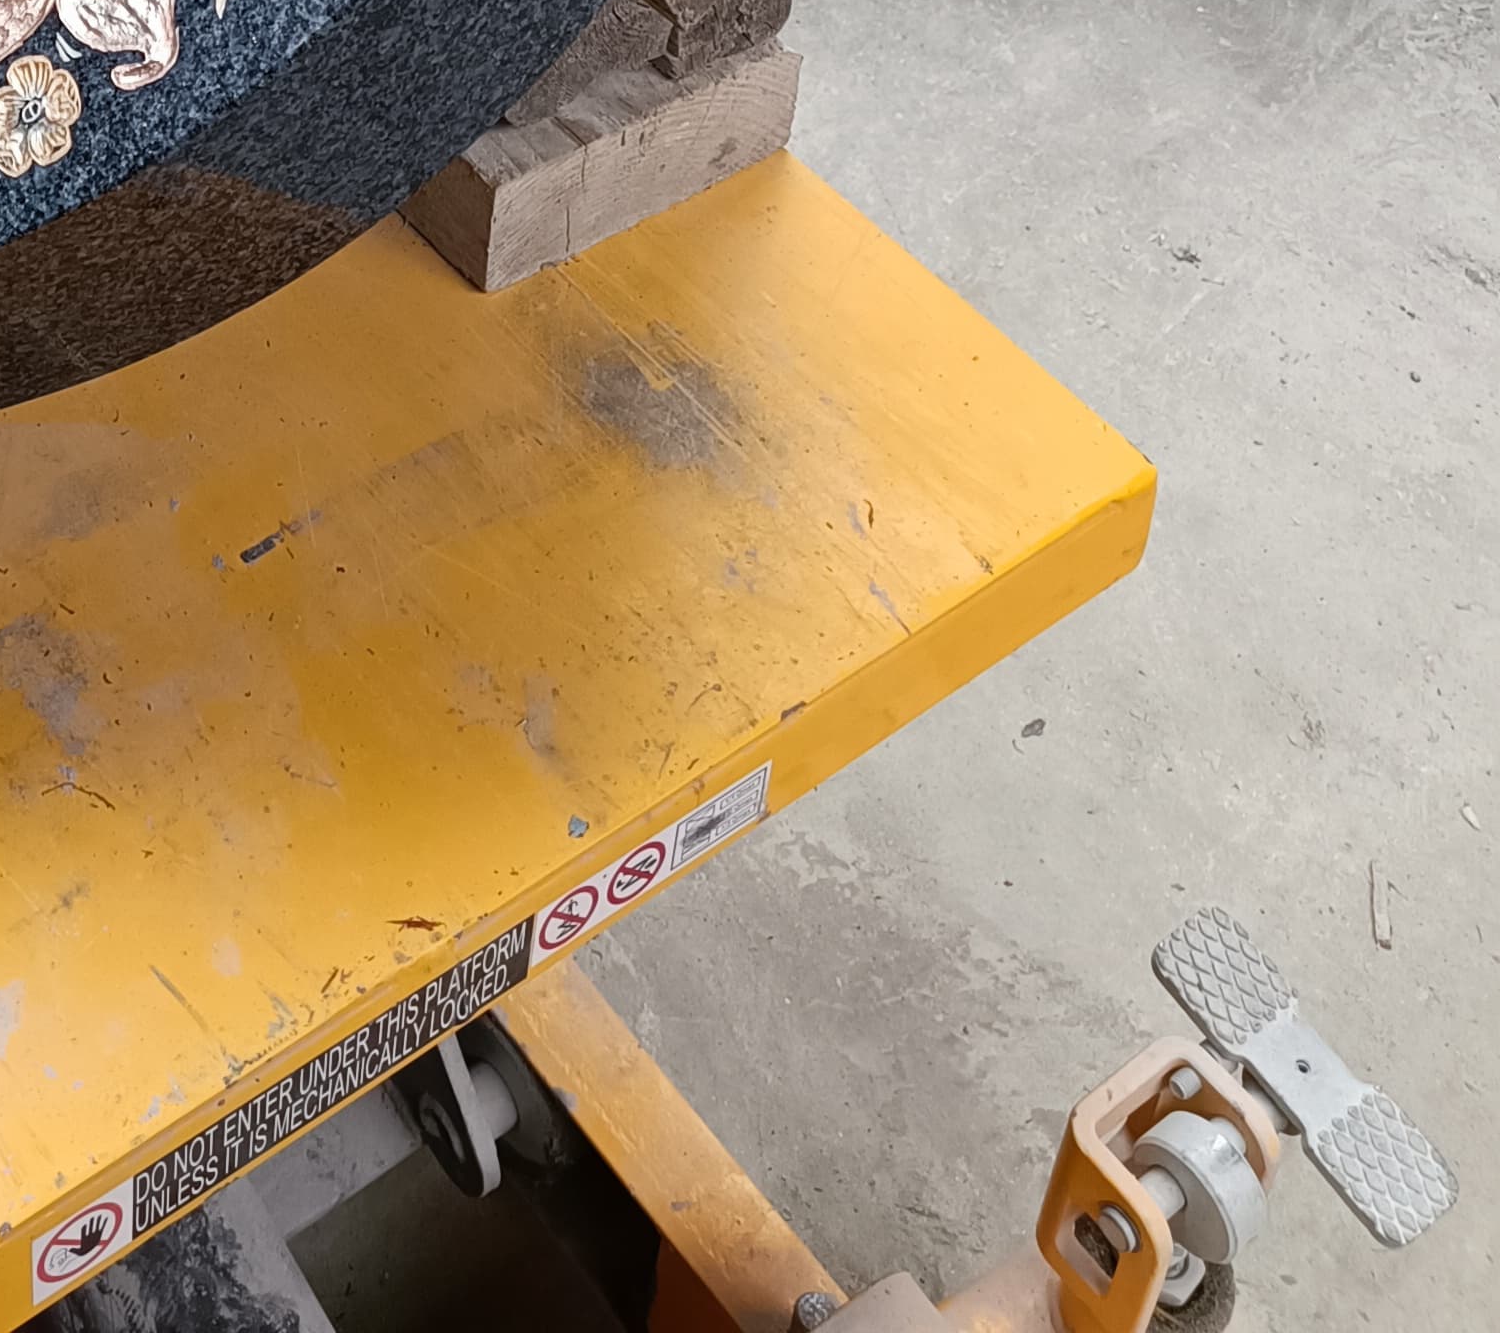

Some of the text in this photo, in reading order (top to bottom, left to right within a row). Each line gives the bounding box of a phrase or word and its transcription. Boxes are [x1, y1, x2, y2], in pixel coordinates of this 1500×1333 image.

[135, 921, 528, 1205] DO NOT ENTER UNDER THIS PLATFORM
[135, 964, 511, 1233] UNLESS IT IS MECHANICALLY LOCKED.
